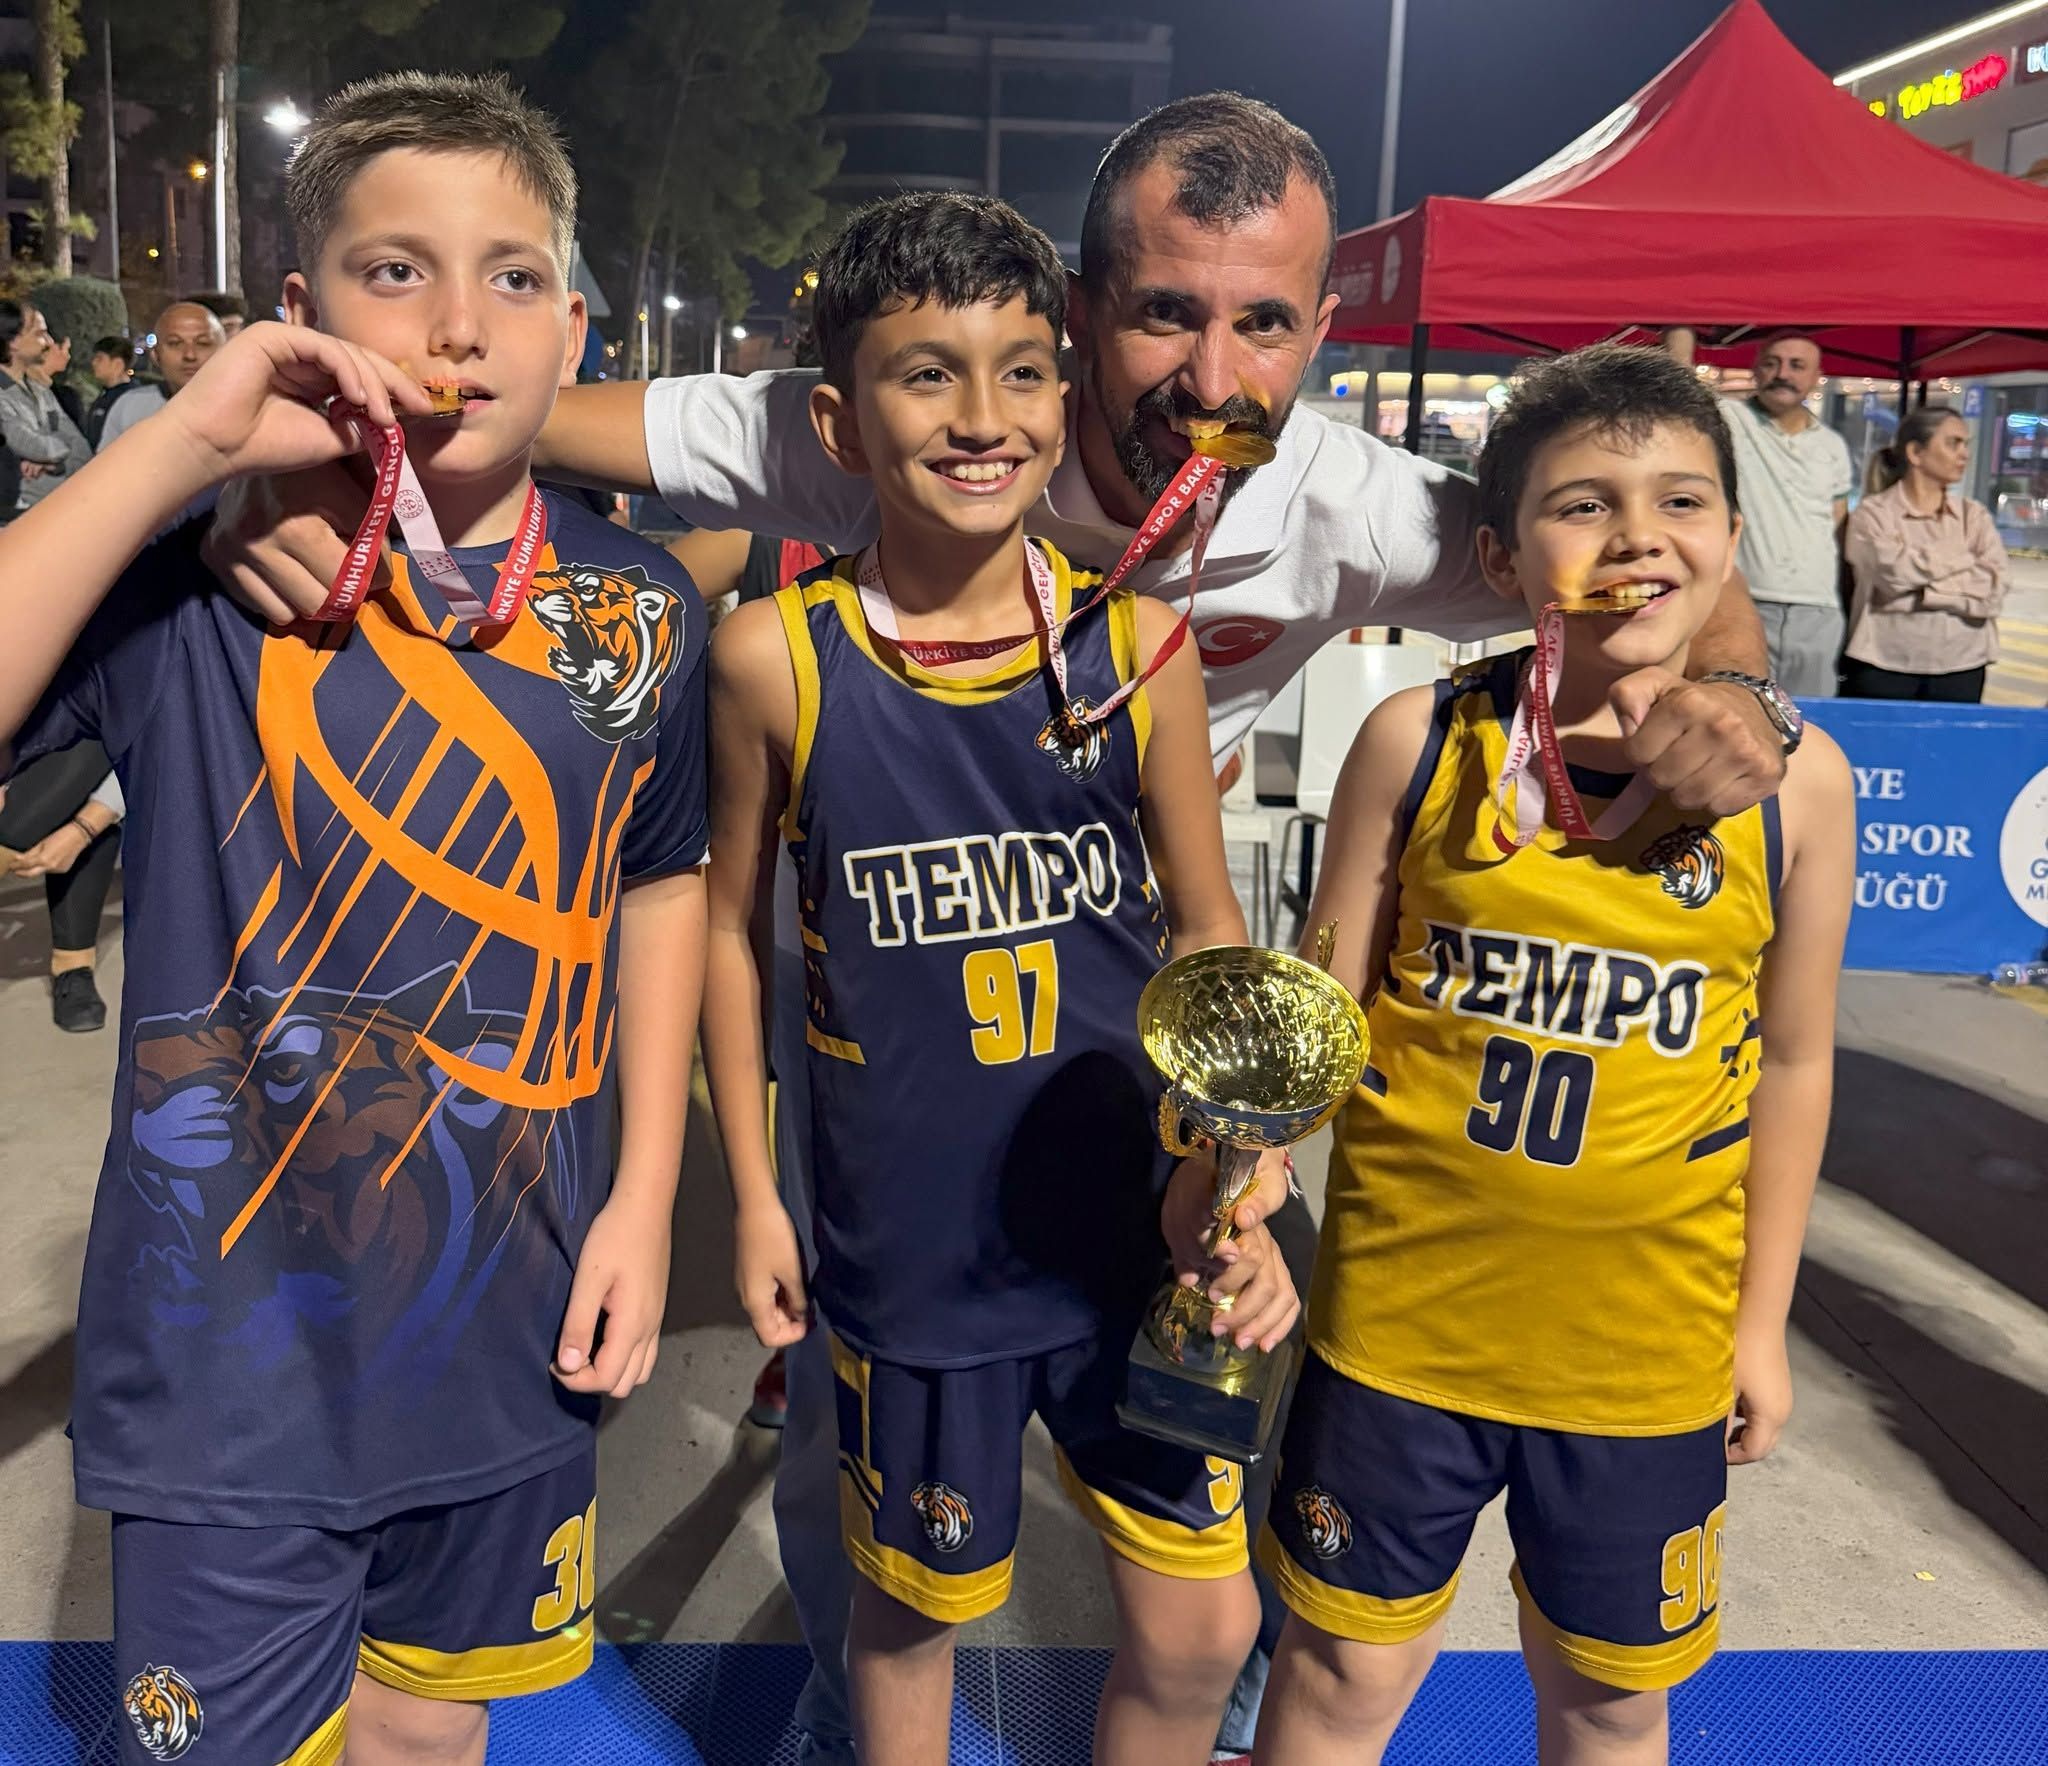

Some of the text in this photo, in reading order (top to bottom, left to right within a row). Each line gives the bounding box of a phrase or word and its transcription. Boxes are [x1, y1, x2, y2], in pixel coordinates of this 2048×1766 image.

[1134, 535, 1151, 555] VE
[1149, 495, 1183, 536] SPOR
[1178, 456, 1215, 496] BAKA
[843, 822, 1121, 947] TEMPO
[1861, 822, 1975, 858] SPOR
[963, 939, 1059, 1065] 97
[1422, 920, 1710, 1057] TEMPO
[1464, 1033, 1596, 1169] 90
[1660, 1500, 1727, 1632] 90
